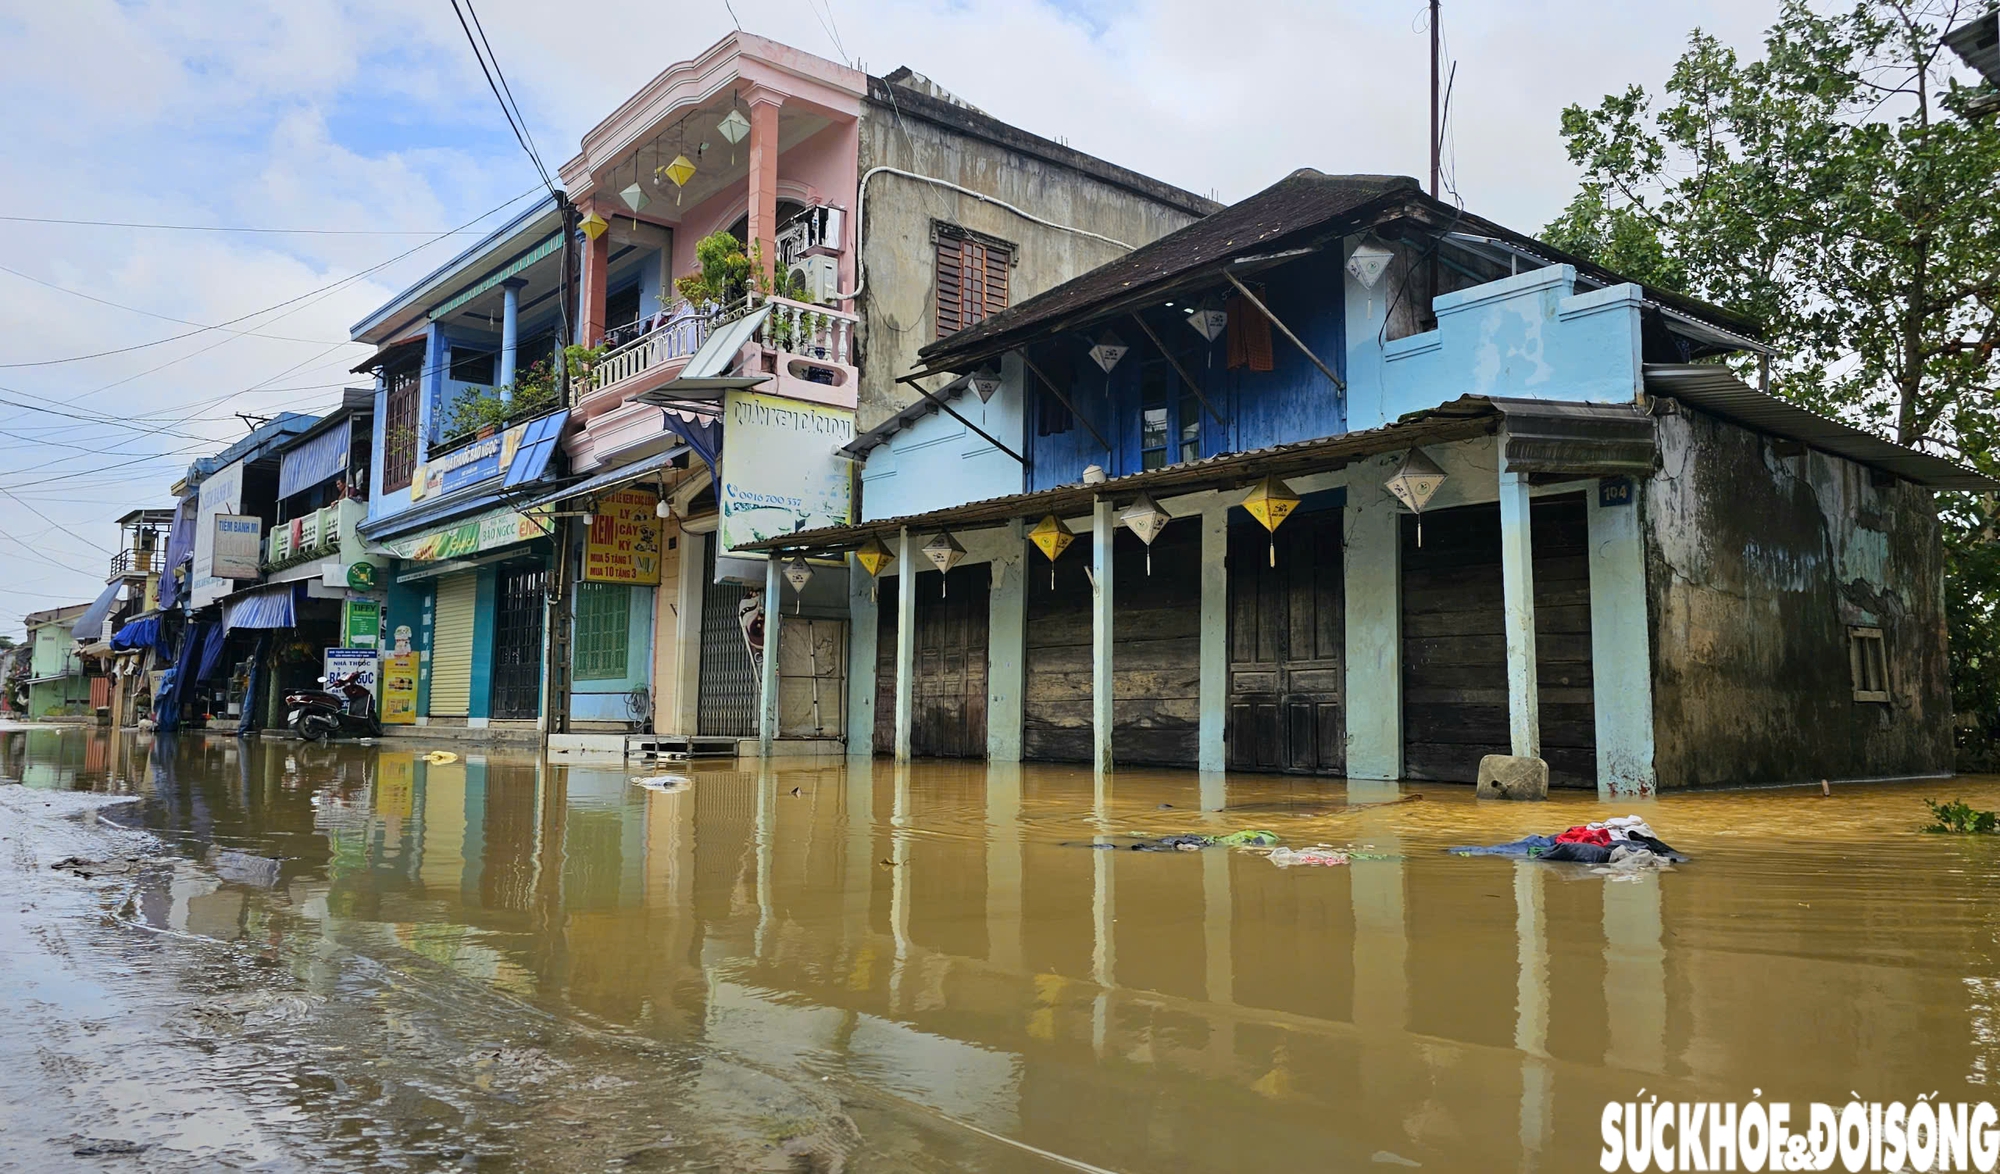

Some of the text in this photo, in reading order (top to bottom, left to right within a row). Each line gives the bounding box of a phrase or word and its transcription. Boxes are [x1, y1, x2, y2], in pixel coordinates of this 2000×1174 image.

[739, 491, 764, 502] 0916
[765, 494, 785, 504] 700
[1604, 485, 1627, 500] 104
[620, 509, 630, 520] LY
[591, 514, 614, 545] KEM
[590, 553, 604, 563] MUA
[605, 552, 610, 564] 5
[628, 555, 632, 565] 1
[590, 567, 604, 577] MUA
[605, 566, 614, 577] 10
[631, 568, 637, 579] 3
[353, 604, 377, 612] TIFFY
